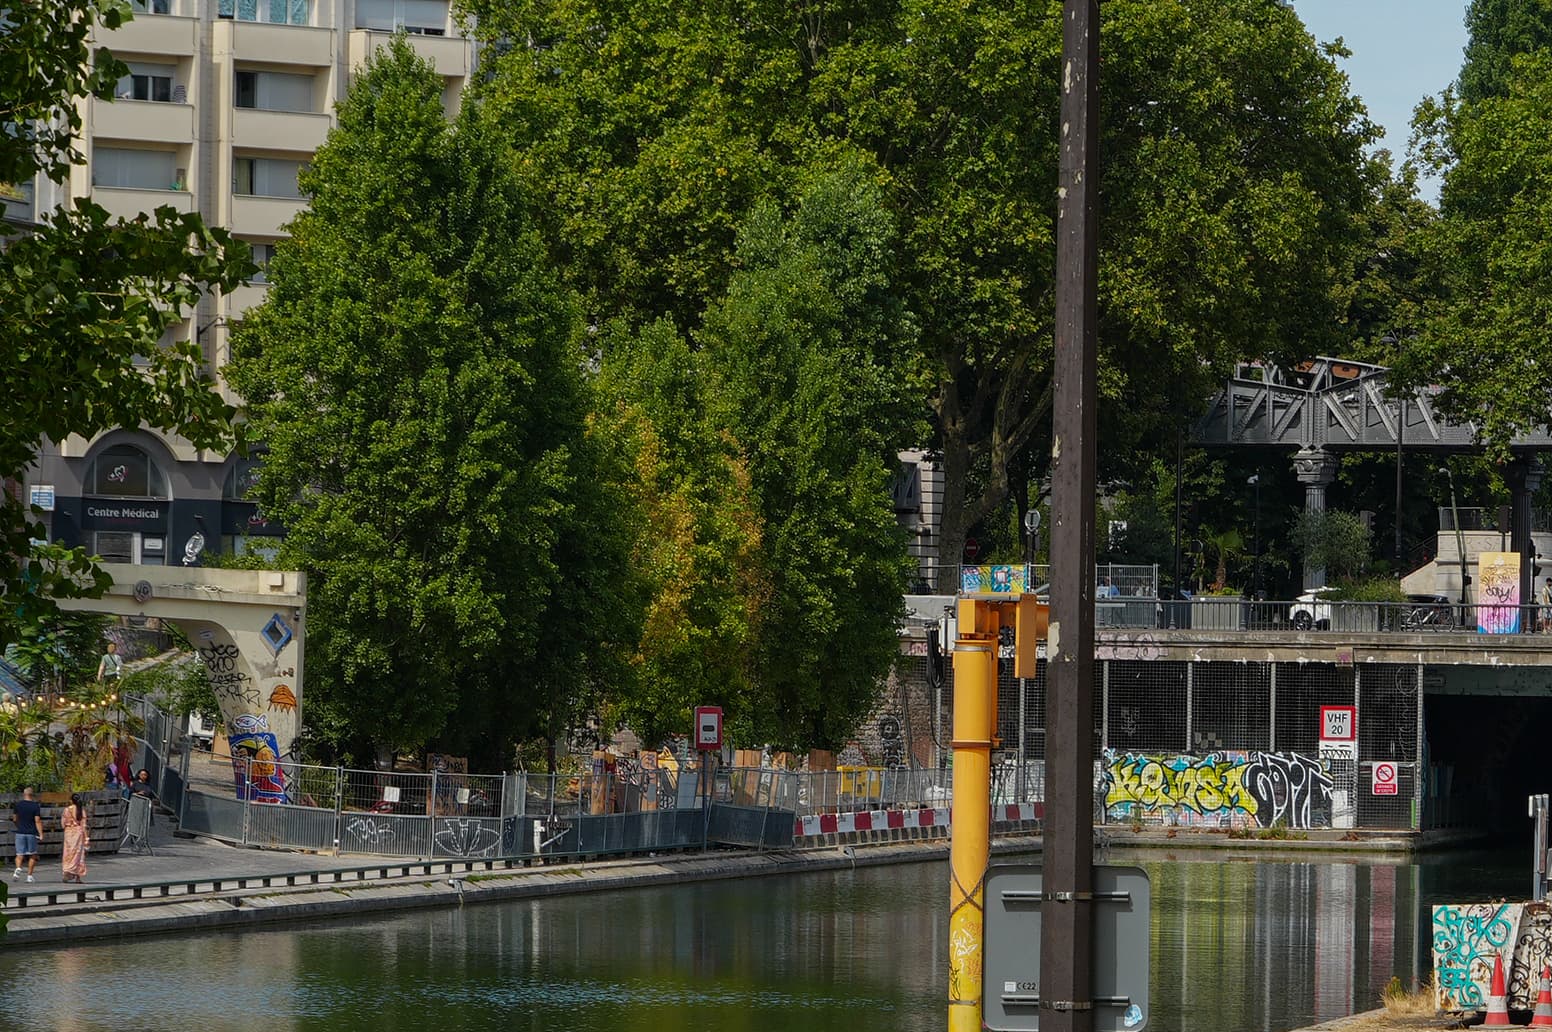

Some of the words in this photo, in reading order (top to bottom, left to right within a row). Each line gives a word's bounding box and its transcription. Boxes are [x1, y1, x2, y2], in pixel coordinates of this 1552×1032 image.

[87, 506, 120, 518] Centre
[121, 507, 160, 519] Médical
[1327, 713, 1348, 723] VHF
[1331, 725, 1344, 735] 20
